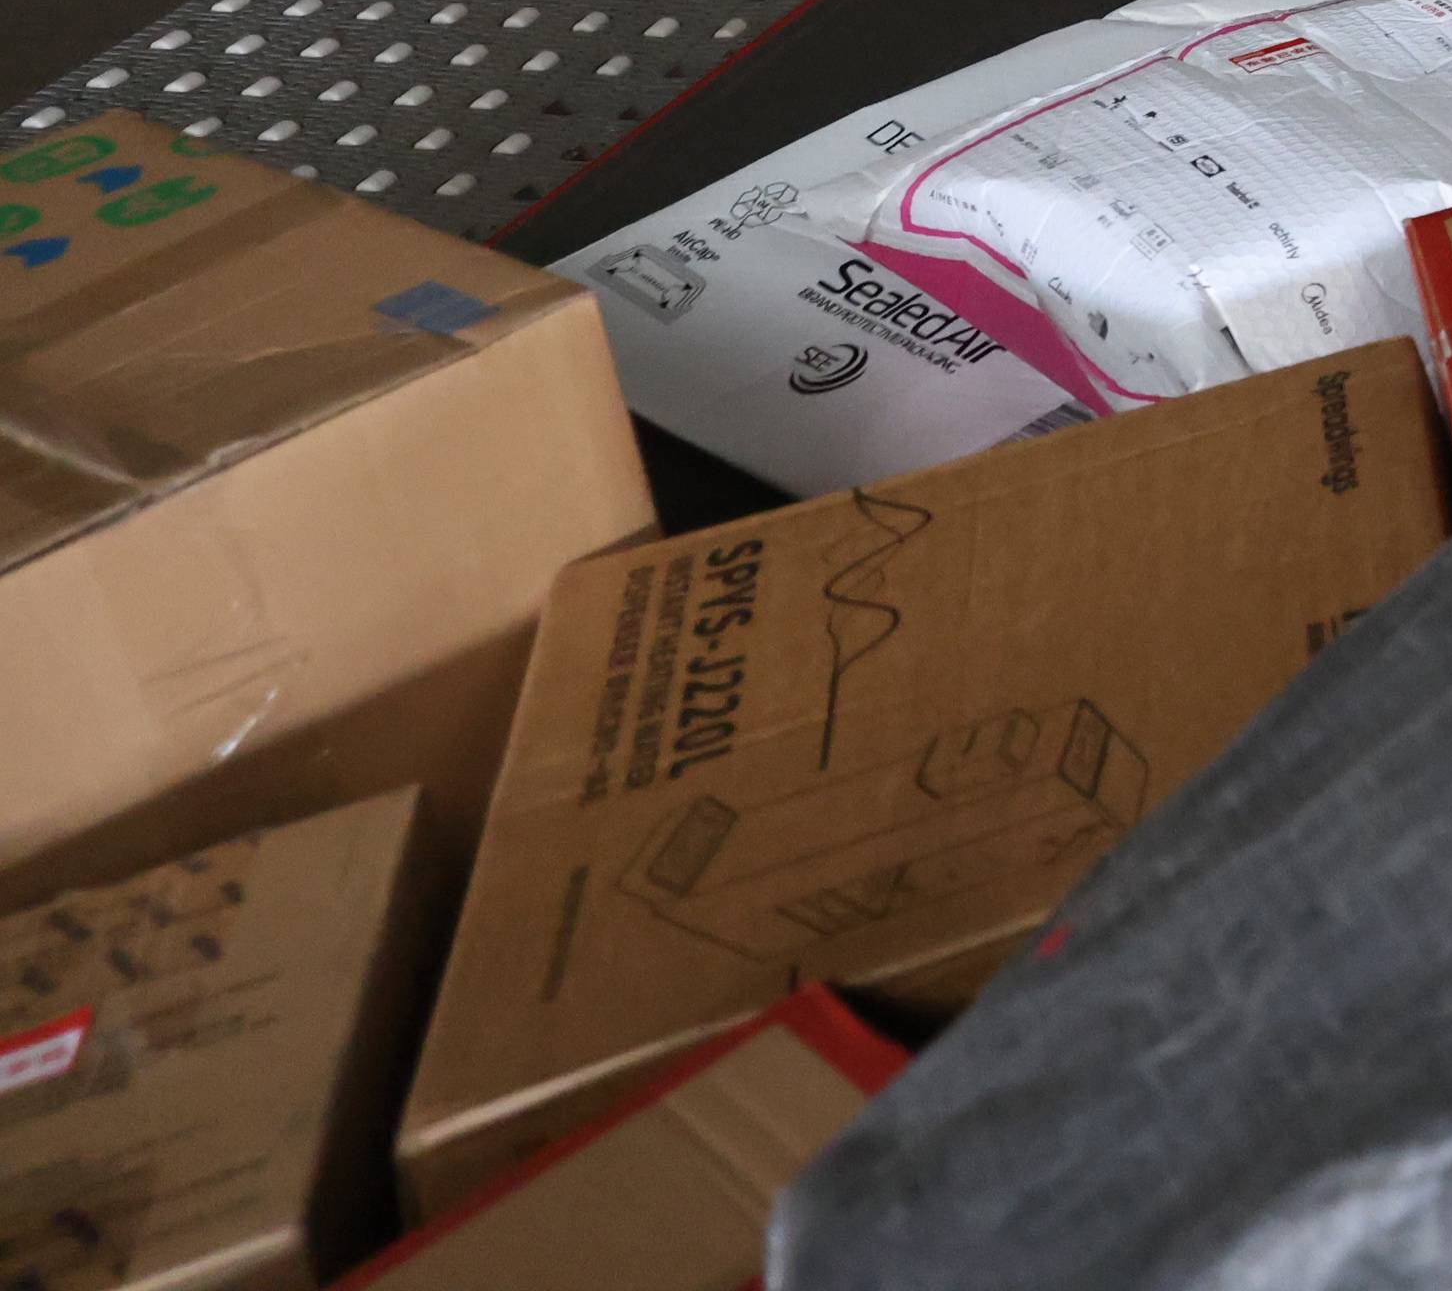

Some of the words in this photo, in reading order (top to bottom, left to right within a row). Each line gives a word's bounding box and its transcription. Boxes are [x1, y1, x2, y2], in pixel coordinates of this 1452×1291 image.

[1268, 222, 1300, 260] ochirly
[1307, 294, 1334, 336] Midea
[668, 539, 763, 780] SPYS-J220L
